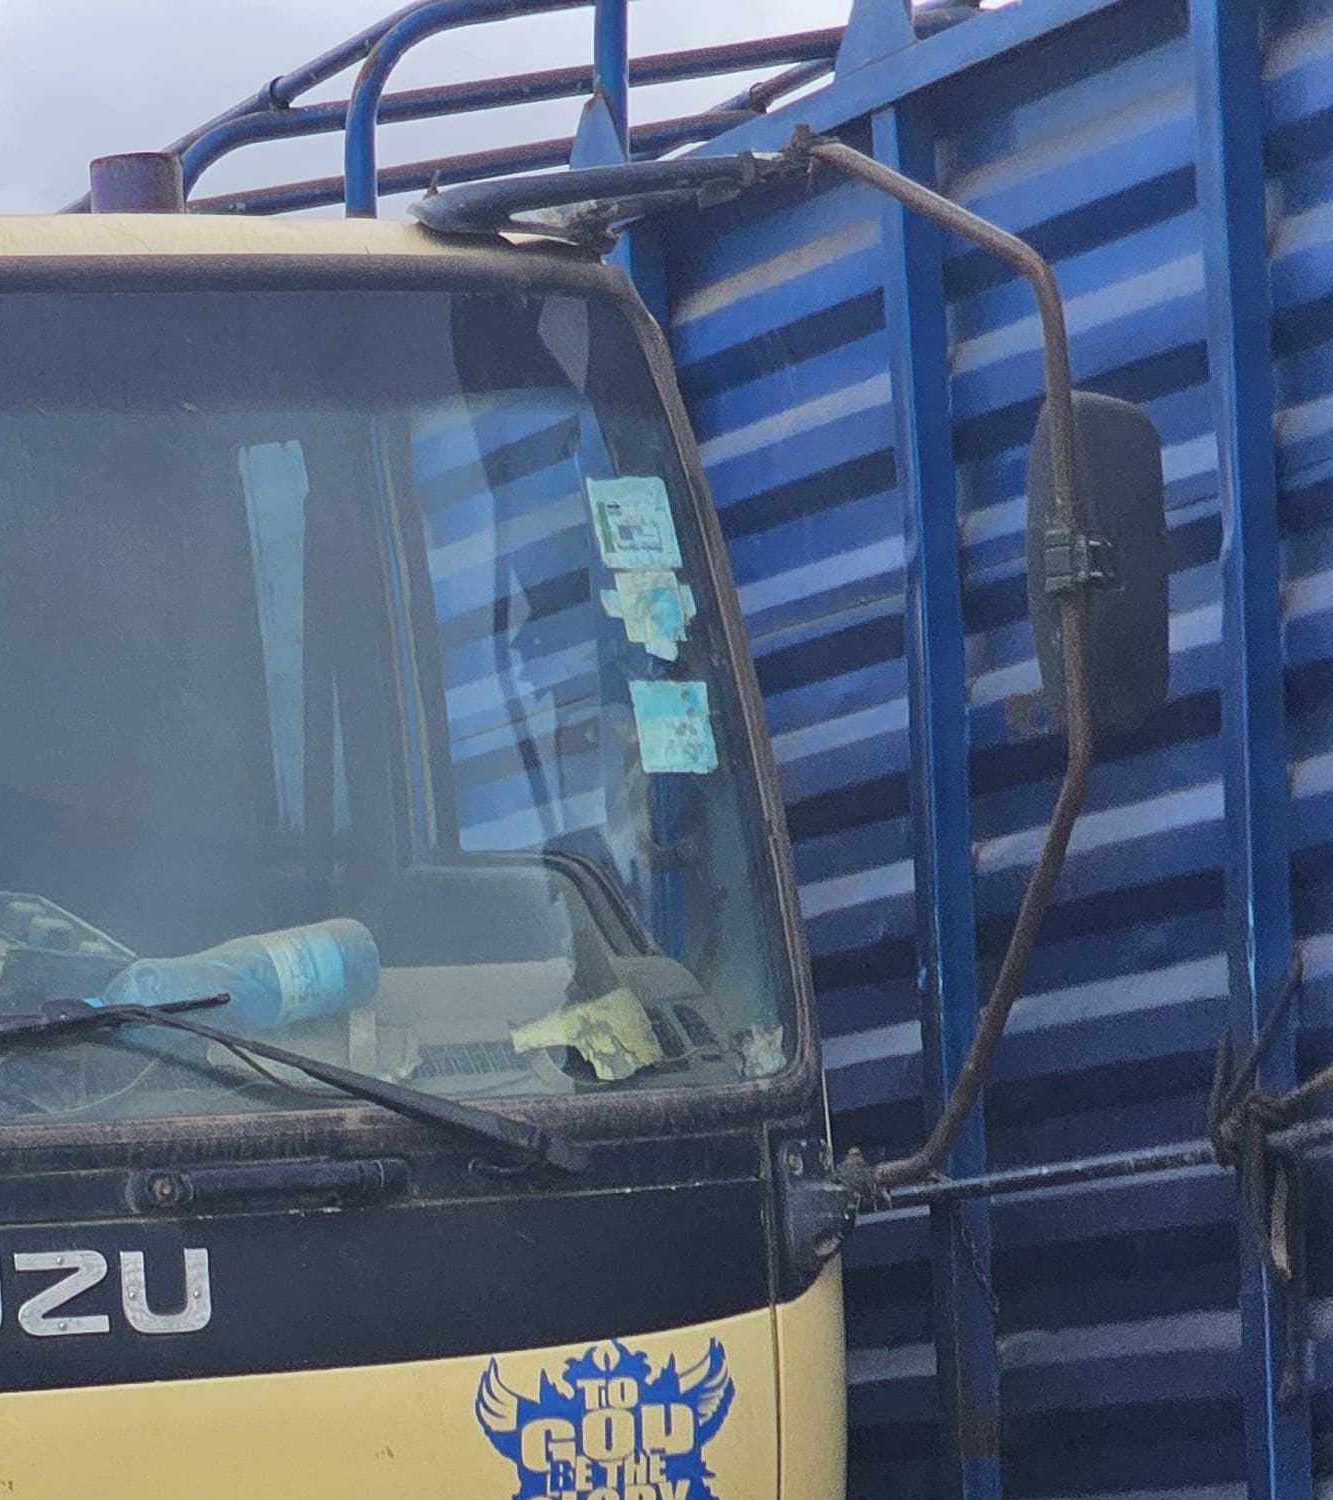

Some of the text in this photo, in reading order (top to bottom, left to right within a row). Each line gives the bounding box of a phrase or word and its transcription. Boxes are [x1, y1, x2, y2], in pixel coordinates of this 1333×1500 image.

[577, 1377, 639, 1410] TO
[547, 1449, 668, 1496] BE THE
